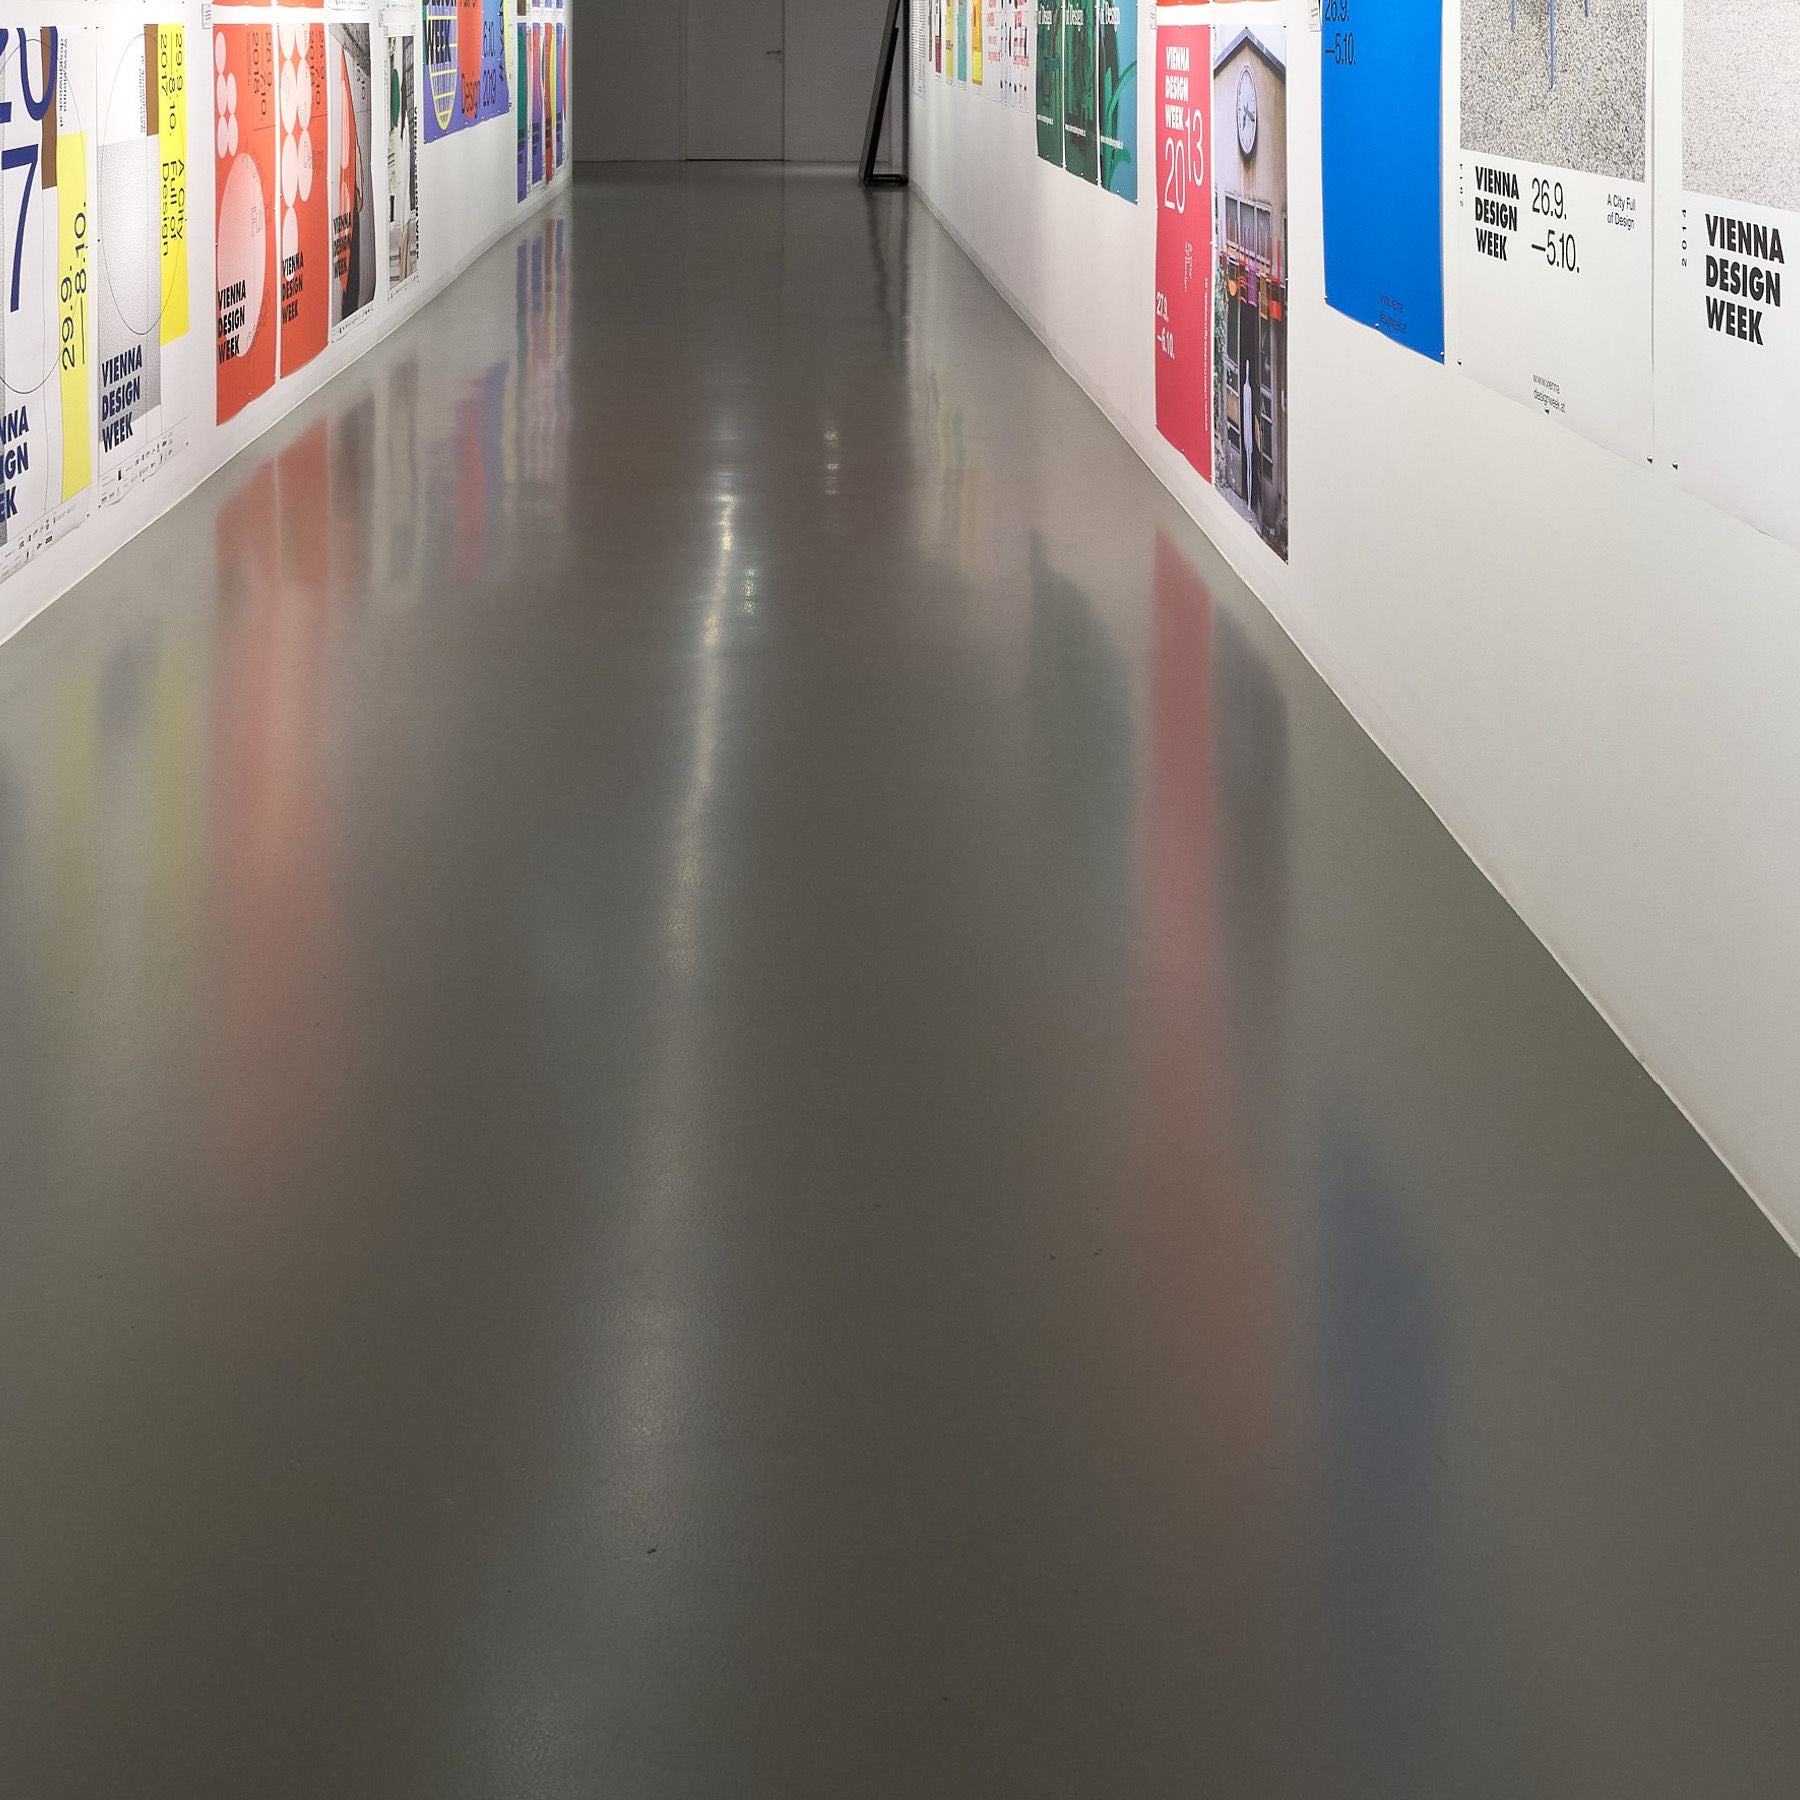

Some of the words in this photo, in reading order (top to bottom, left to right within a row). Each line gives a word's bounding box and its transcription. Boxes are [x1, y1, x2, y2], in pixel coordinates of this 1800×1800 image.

[159, 33, 168, 96] 2017
[424, 19, 451, 66] WEEK
[1166, 46, 1190, 72] VIENNA
[1165, 75, 1189, 102] DESIGN
[1165, 103, 1184, 131] WEEK
[161, 162, 170, 256] Design
[1474, 165, 1520, 200] VIENNA
[1531, 177, 1567, 221] 26.9.
[1474, 196, 1517, 232] DESIGN
[1475, 227, 1507, 261] WEEK
[1705, 213, 1785, 264] VIENNA
[217, 280, 246, 311] VIENNA
[1705, 254, 1781, 307] DESIGN
[60, 264, 75, 370] 29.9.
[218, 305, 245, 339] DESIGN
[1705, 295, 1763, 346] WEEK
[102, 344, 143, 388] VIENNA
[218, 334, 240, 364] WEEK
[101, 376, 141, 422] DESIGN
[102, 411, 134, 453] WEEK
